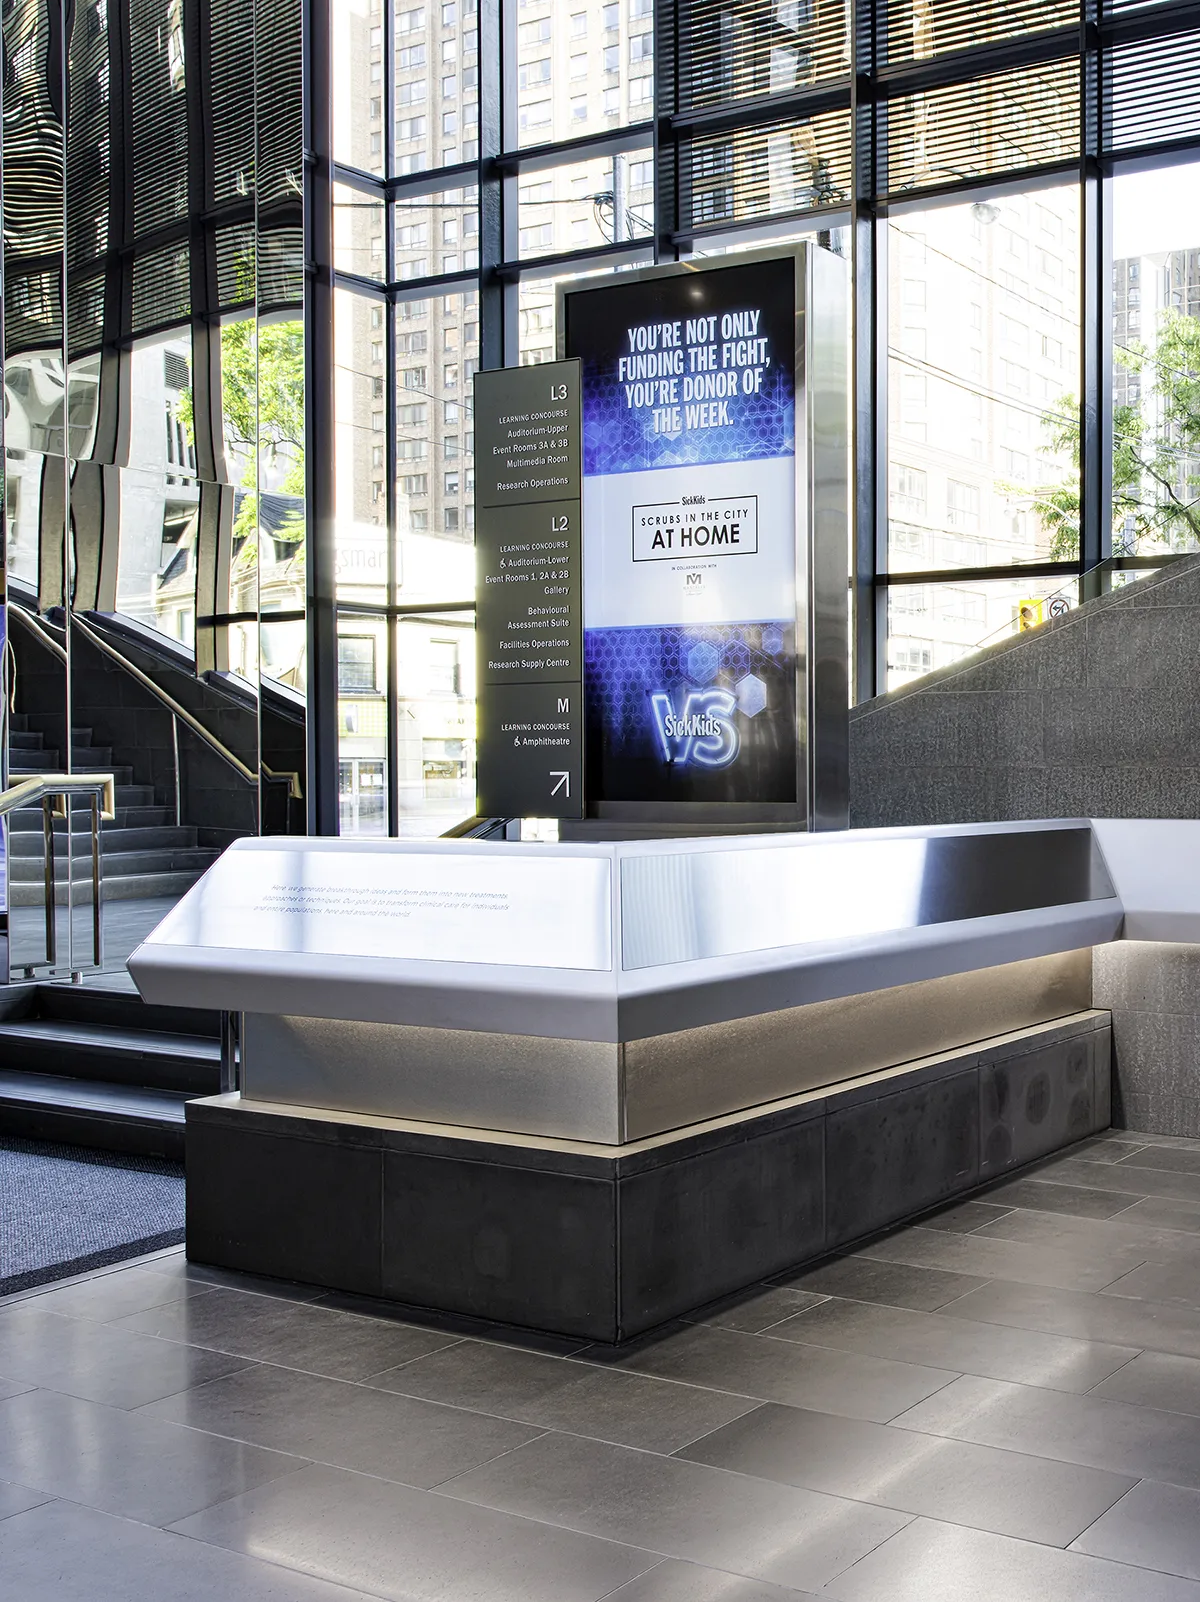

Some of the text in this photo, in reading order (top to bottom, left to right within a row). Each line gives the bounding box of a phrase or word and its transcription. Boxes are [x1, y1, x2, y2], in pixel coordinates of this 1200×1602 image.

[628, 310, 760, 352] YOU'RE NOT ONLY
[619, 338, 770, 381] FUNDING THE FIGHT,
[551, 384, 568, 400] L3
[625, 368, 763, 408] YOU'RE DONOR OF
[499, 409, 568, 424] LEARNING CONCOURSE
[652, 401, 734, 433] THE WEEK.
[508, 425, 568, 438] Auditorium-Upper
[493, 439, 568, 455] Event Rooms 3A & 3B
[507, 455, 568, 468] Multimedia Room
[497, 477, 568, 491] Research Operations
[682, 495, 705, 506] SickKids
[552, 516, 569, 532] L2
[641, 509, 748, 526] SCRUBS IN THE CITY
[652, 524, 740, 549] AT HOME
[500, 541, 569, 553] LEARNING CONCOURSE
[509, 557, 569, 567] Auditorium-Lower
[506, 573, 529, 582] Rooms
[531, 573, 538, 582] 1,
[540, 571, 549, 580] 2A
[544, 586, 569, 595] Gallery
[528, 605, 569, 615] Behavioural
[508, 619, 569, 629] Assessment Suite
[500, 639, 569, 649] Facilities Operations
[489, 659, 569, 669] Research Supply Centre
[558, 698, 569, 713] M
[652, 690, 736, 765] VS
[665, 714, 720, 737] SickKids
[523, 738, 570, 747] Amphitheatre
